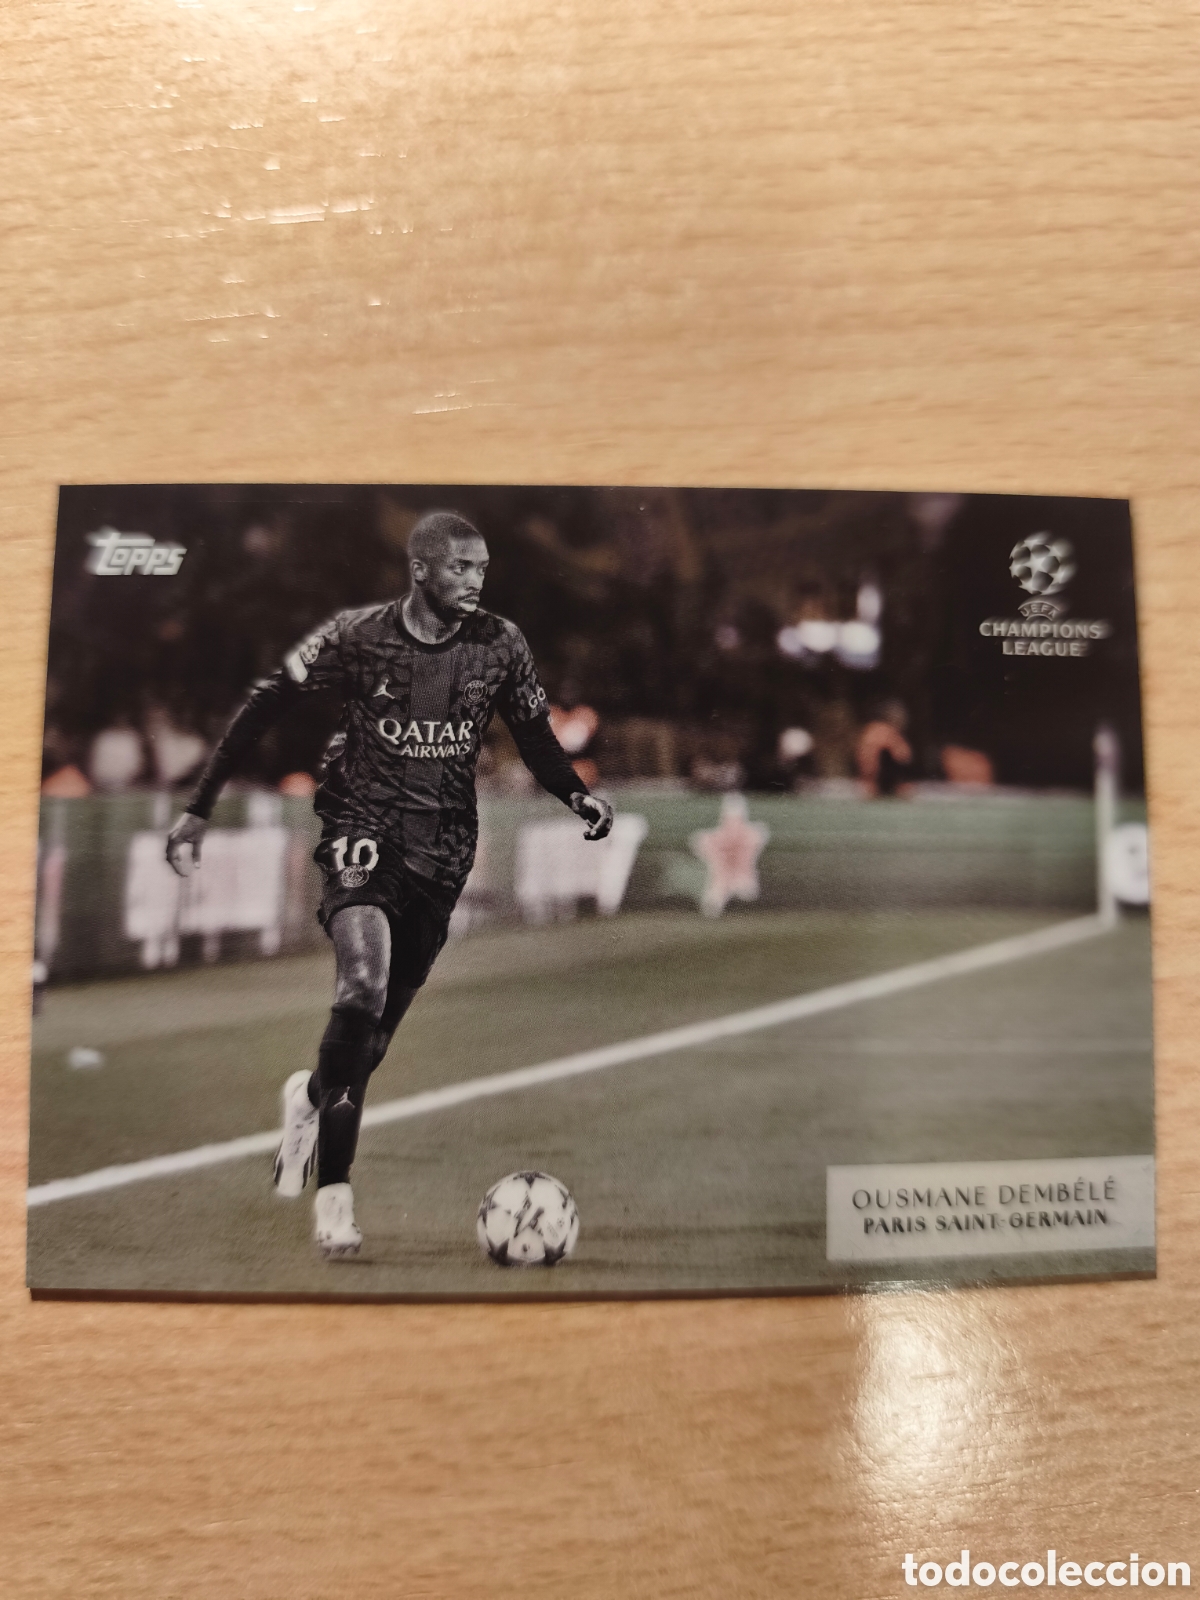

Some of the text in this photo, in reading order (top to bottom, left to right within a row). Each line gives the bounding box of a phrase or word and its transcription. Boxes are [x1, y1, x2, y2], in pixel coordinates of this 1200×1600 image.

[1019, 603, 1058, 617] UEFA
[979, 622, 1102, 639] CHAMPIONS
[1002, 641, 1082, 656] LEAGUE
[377, 718, 474, 745] QATAR
[400, 742, 471, 759] AIRWAYS
[331, 836, 380, 872] 10
[852, 1176, 1116, 1210] OUSMANE DEMBÉLÉ
[862, 1208, 1108, 1235] PARIS SAINT-GERMAIN
